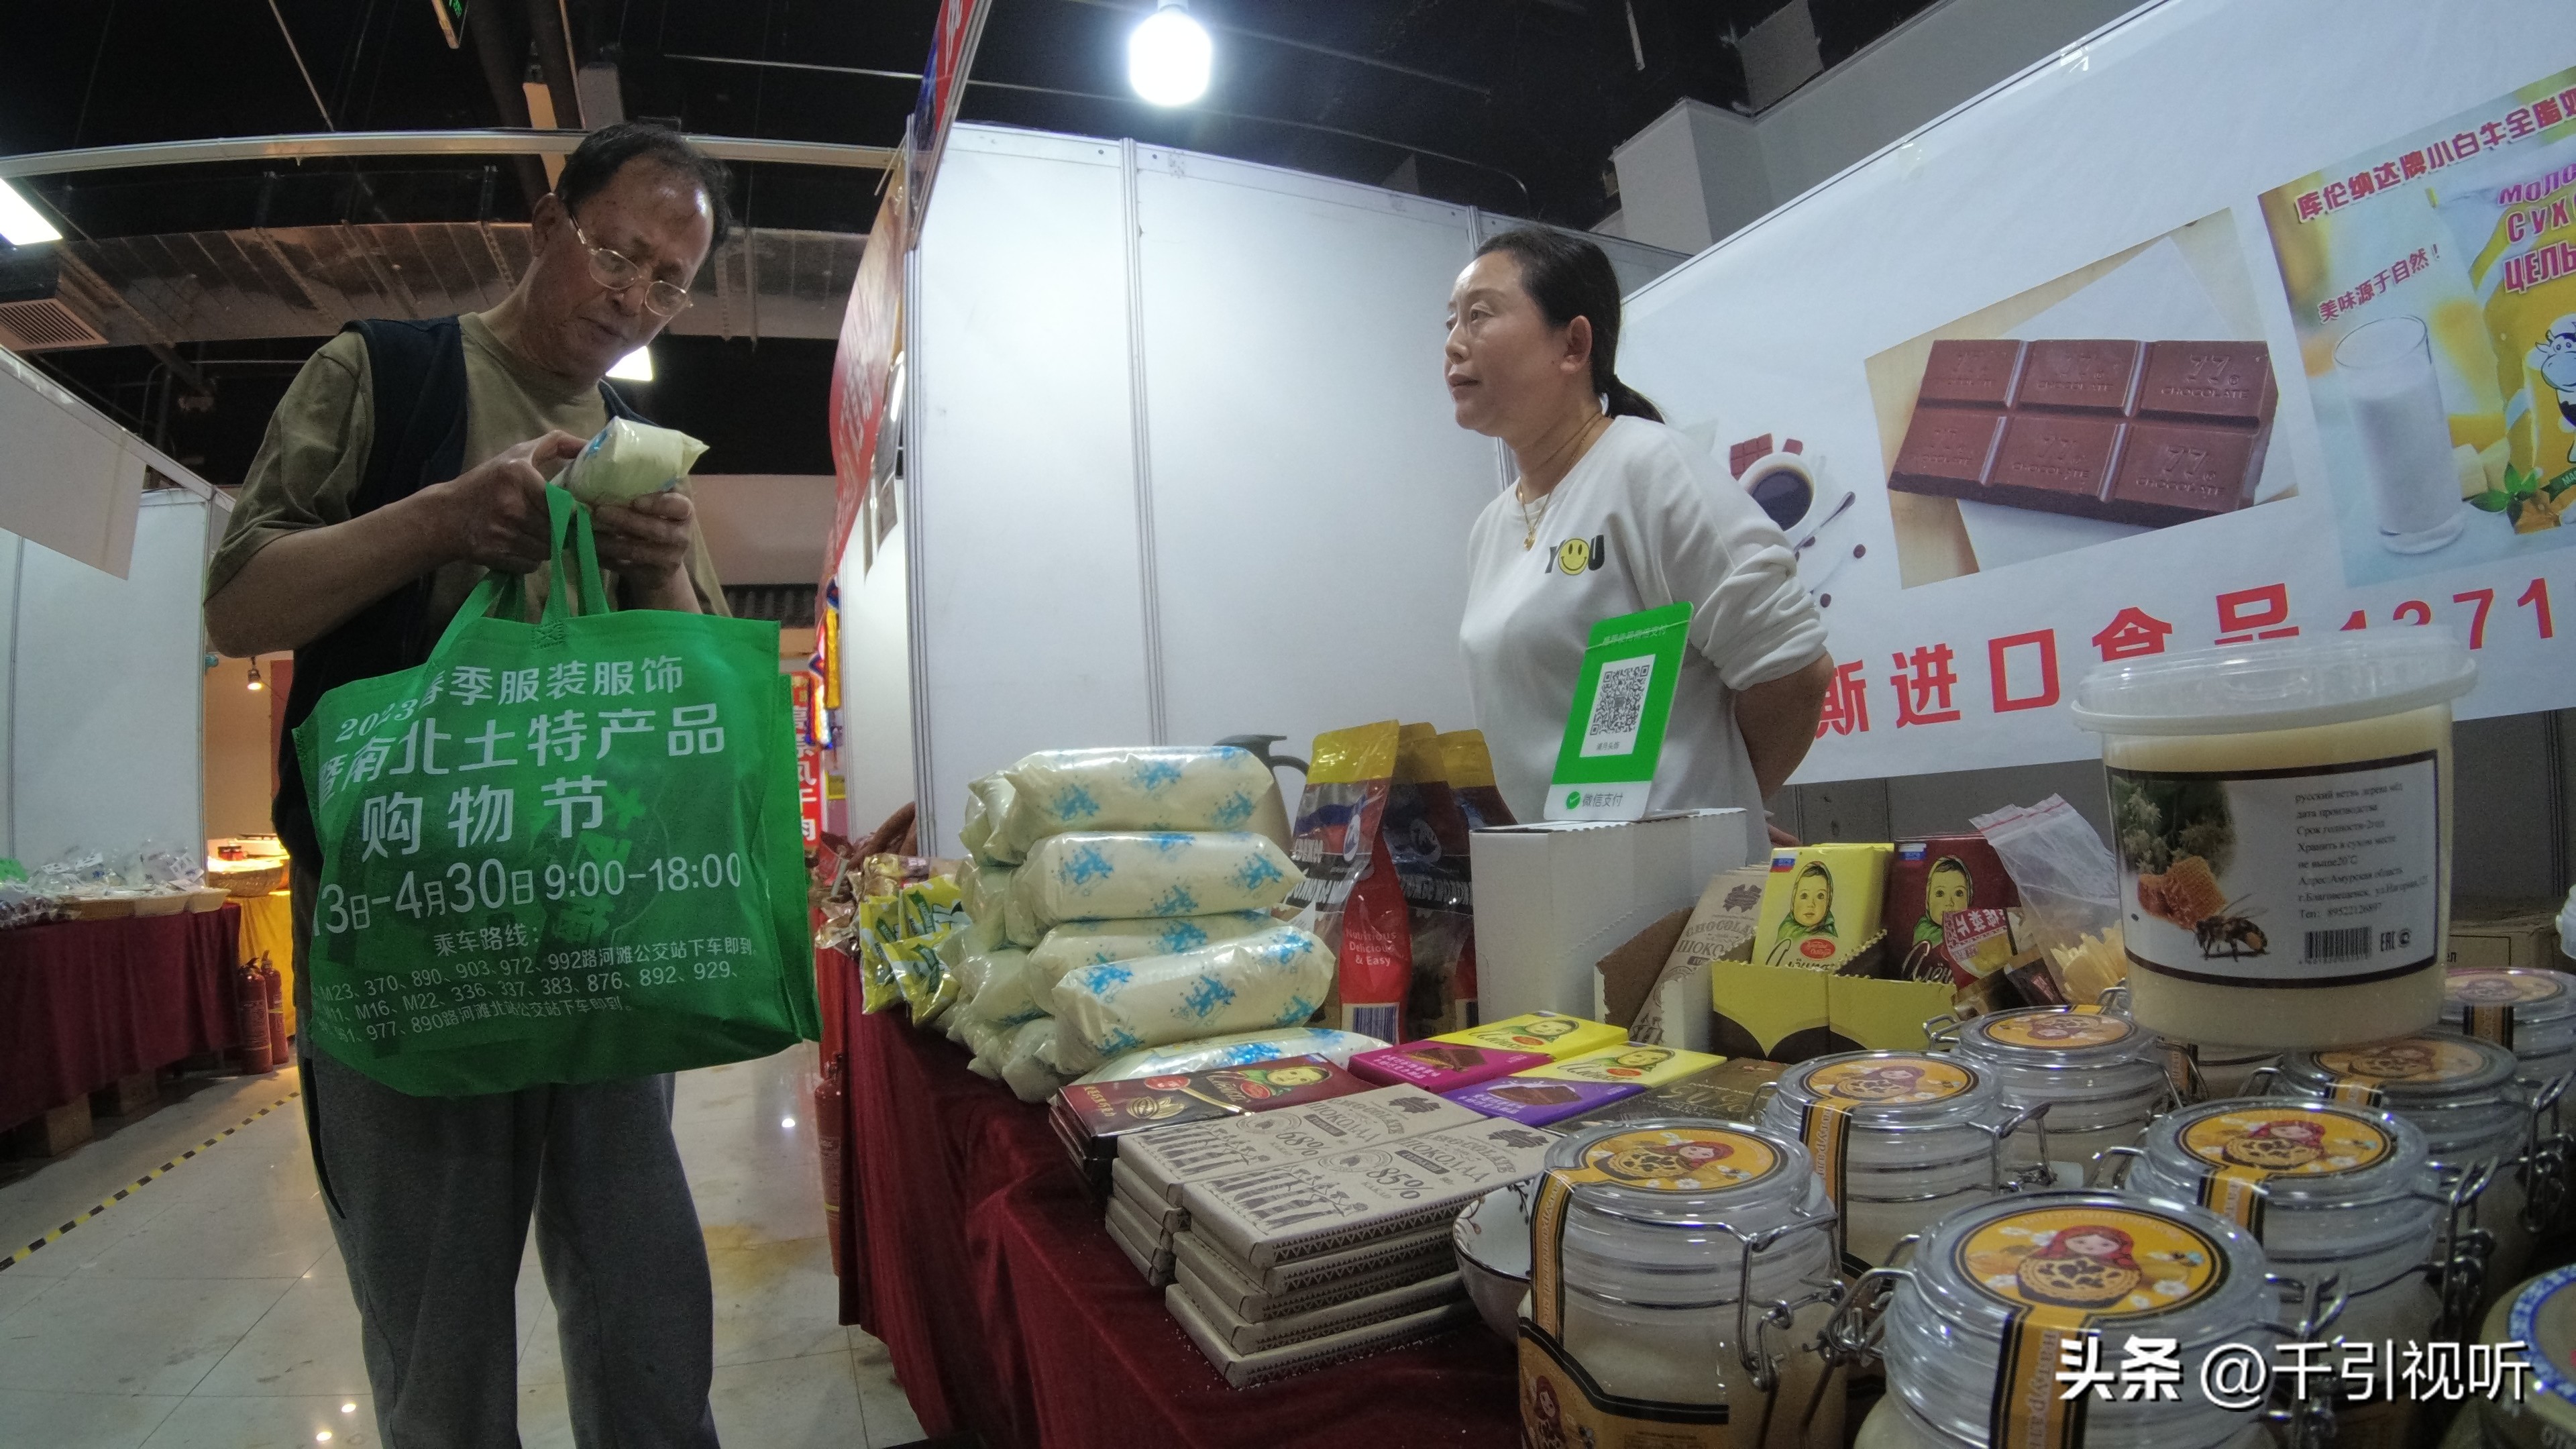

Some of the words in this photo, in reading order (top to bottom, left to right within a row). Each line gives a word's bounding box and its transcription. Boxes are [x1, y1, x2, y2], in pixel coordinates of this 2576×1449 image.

[2506, 195, 2576, 243] СУХ
[1582, 793, 1623, 808] 微信支付
[362, 775, 608, 863] 购物节
[1366, 955, 1391, 967] Easy
[1276, 1131, 1332, 1157] 68%
[1366, 1167, 1434, 1199] 85%
